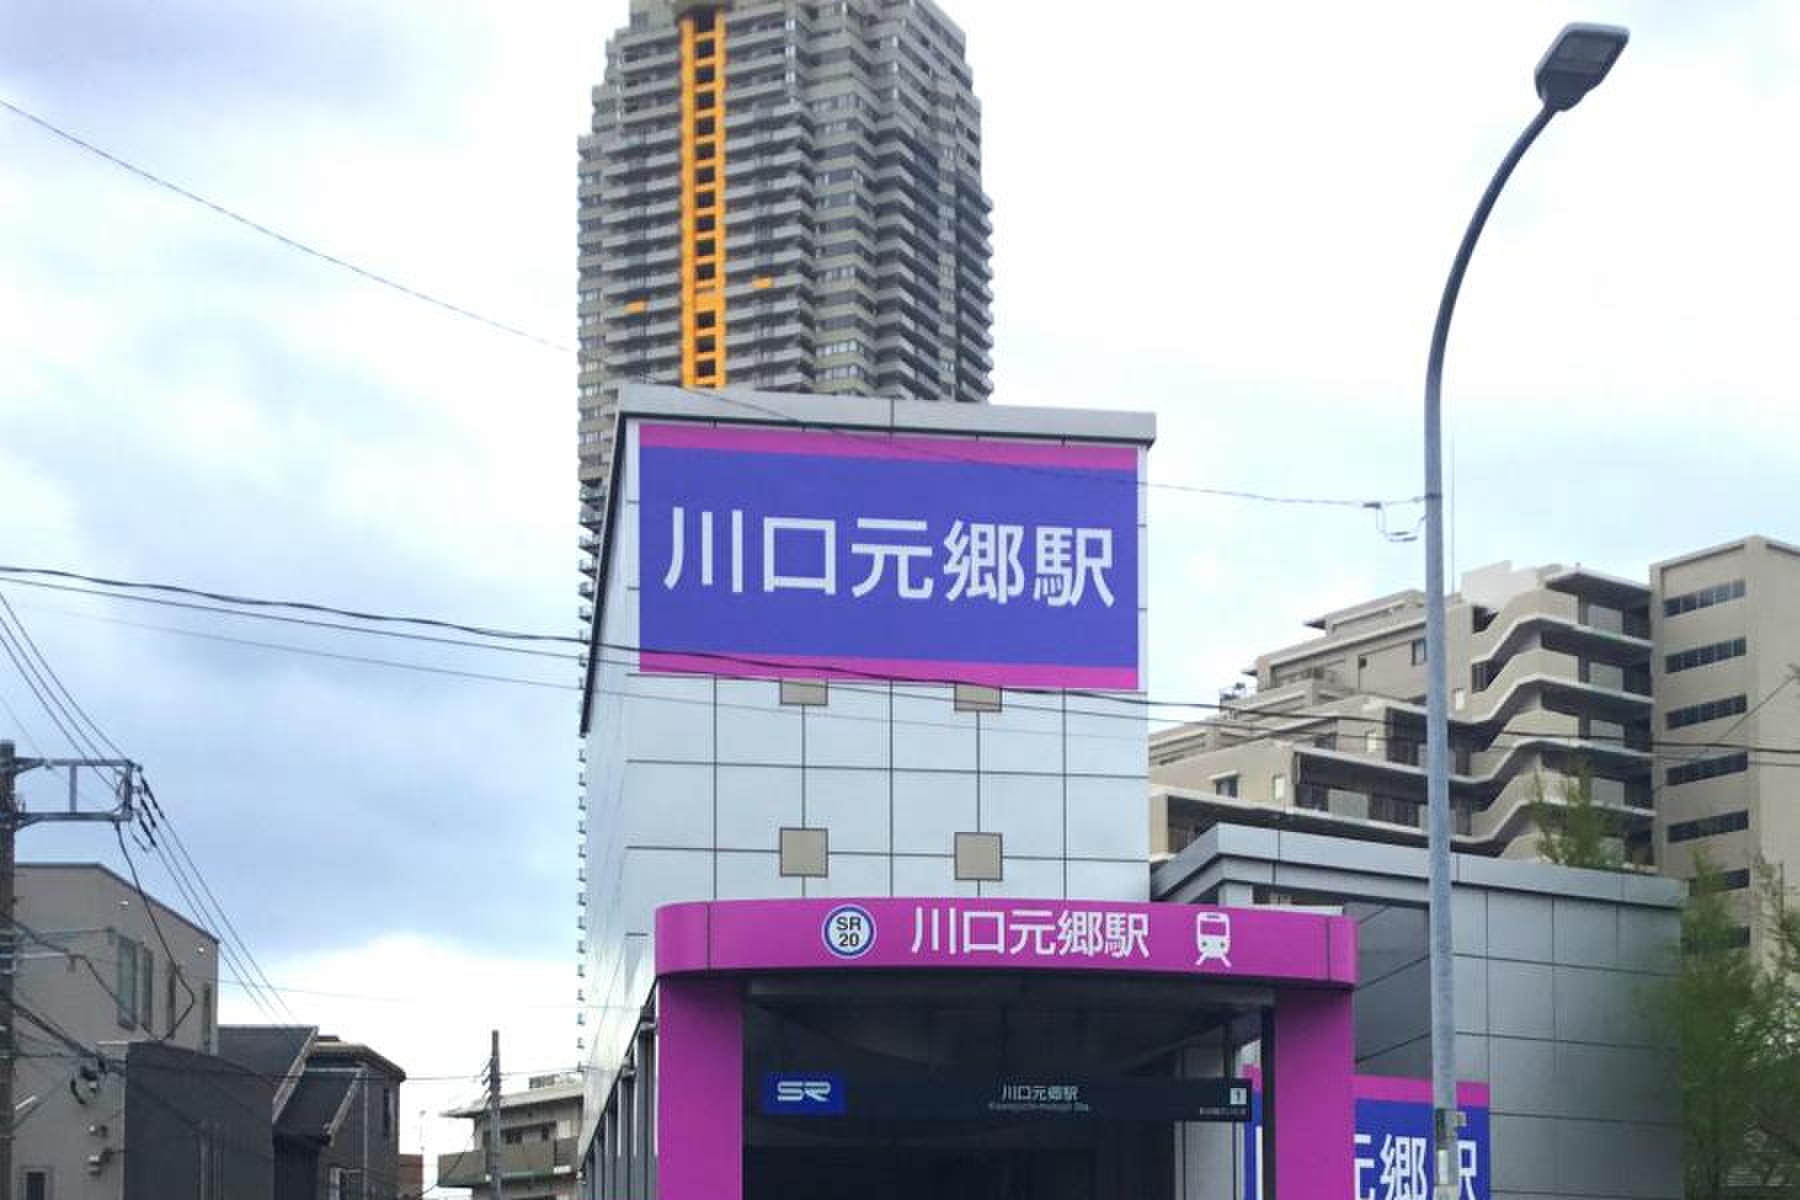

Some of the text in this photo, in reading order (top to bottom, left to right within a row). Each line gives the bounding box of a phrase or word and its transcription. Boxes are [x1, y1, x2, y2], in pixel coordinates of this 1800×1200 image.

[664, 507, 1115, 607] 川口元郷駅
[836, 916, 861, 931] SR
[911, 906, 1150, 958] 川口元郷駅
[839, 932, 860, 947] 20
[777, 1081, 831, 1102] SR
[1002, 1083, 1078, 1101] 川口元郷駅
